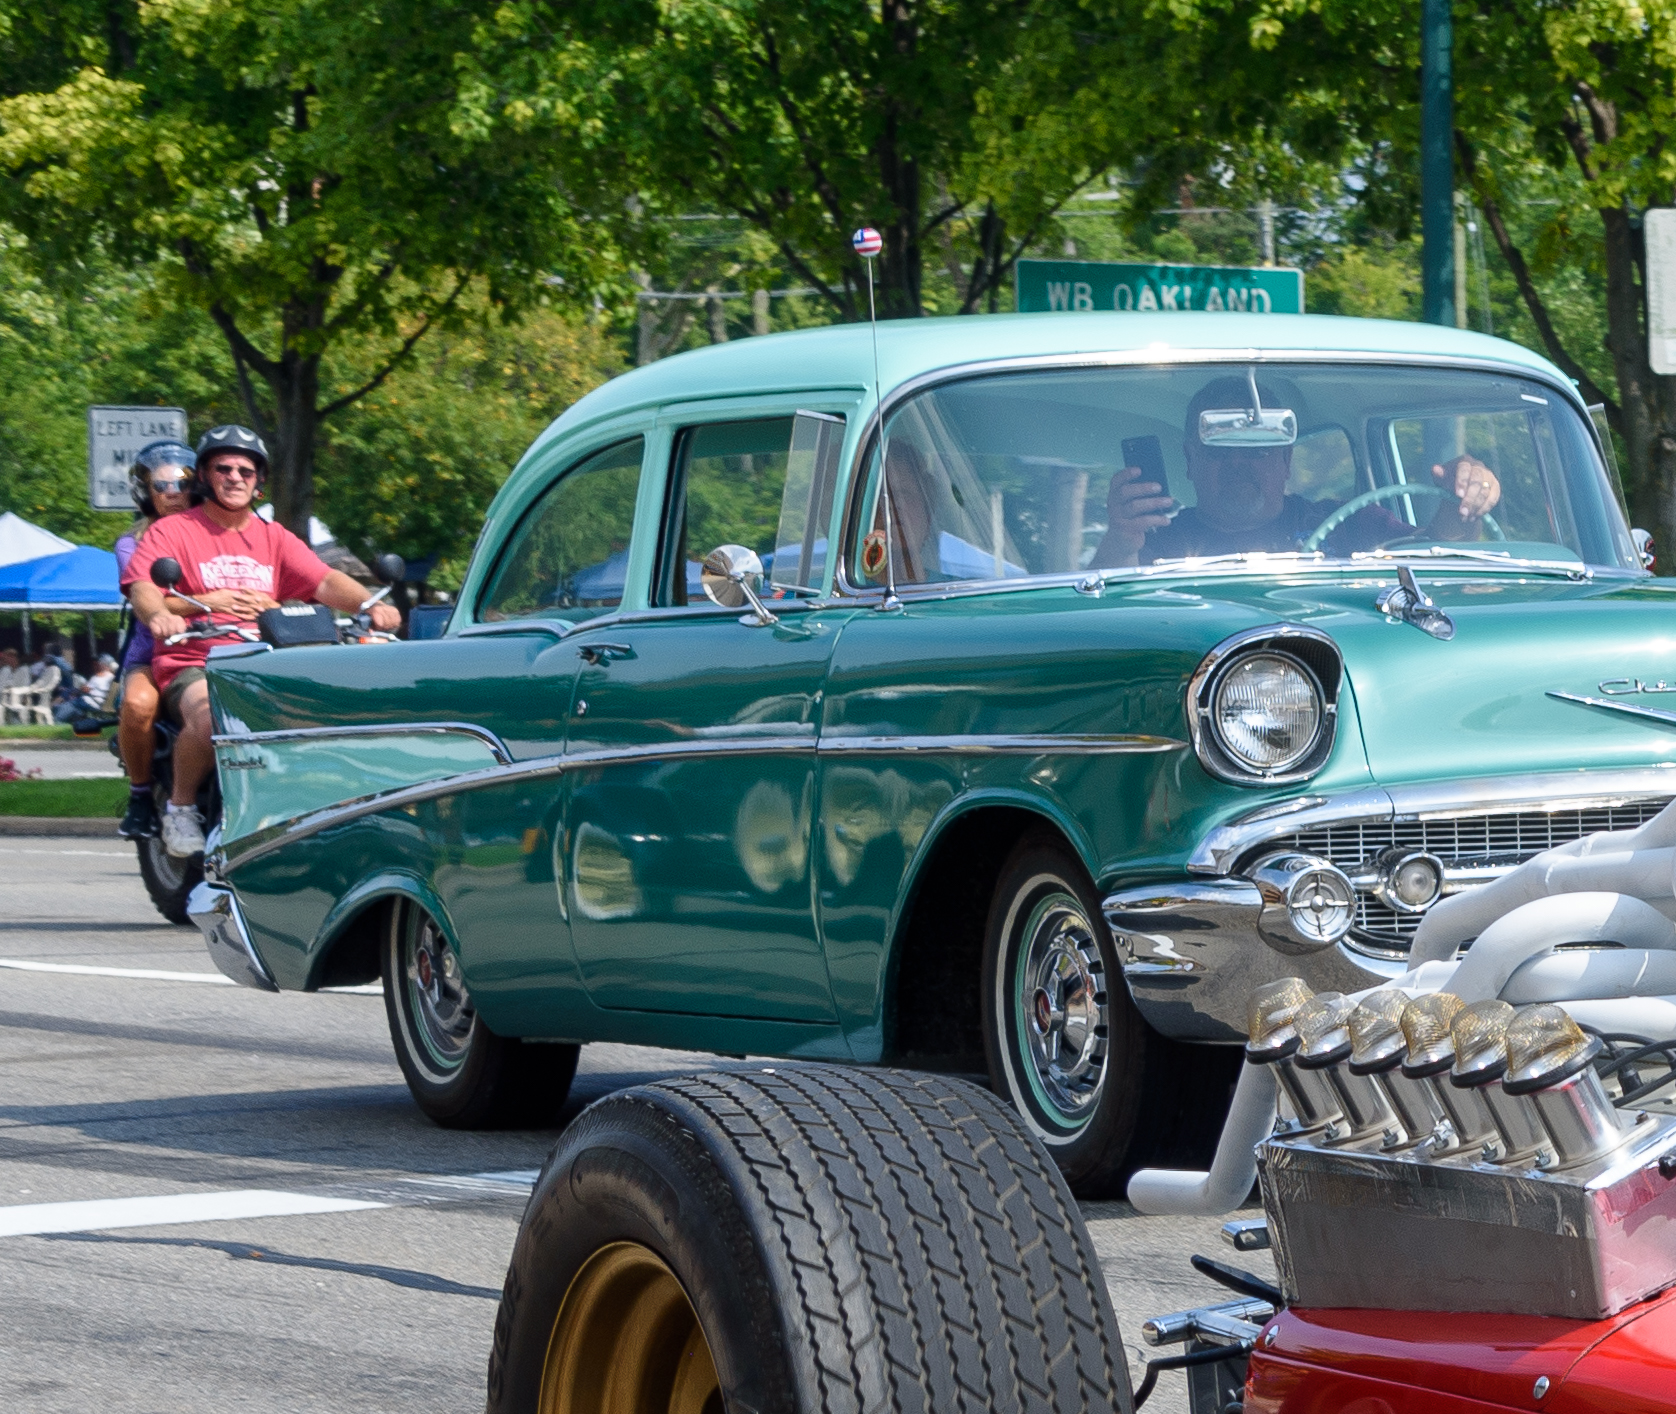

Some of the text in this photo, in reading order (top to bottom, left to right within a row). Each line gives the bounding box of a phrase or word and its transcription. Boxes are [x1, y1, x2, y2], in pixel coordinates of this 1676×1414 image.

[1047, 281, 1094, 311] WB
[97, 420, 176, 437] LEFT LANE
